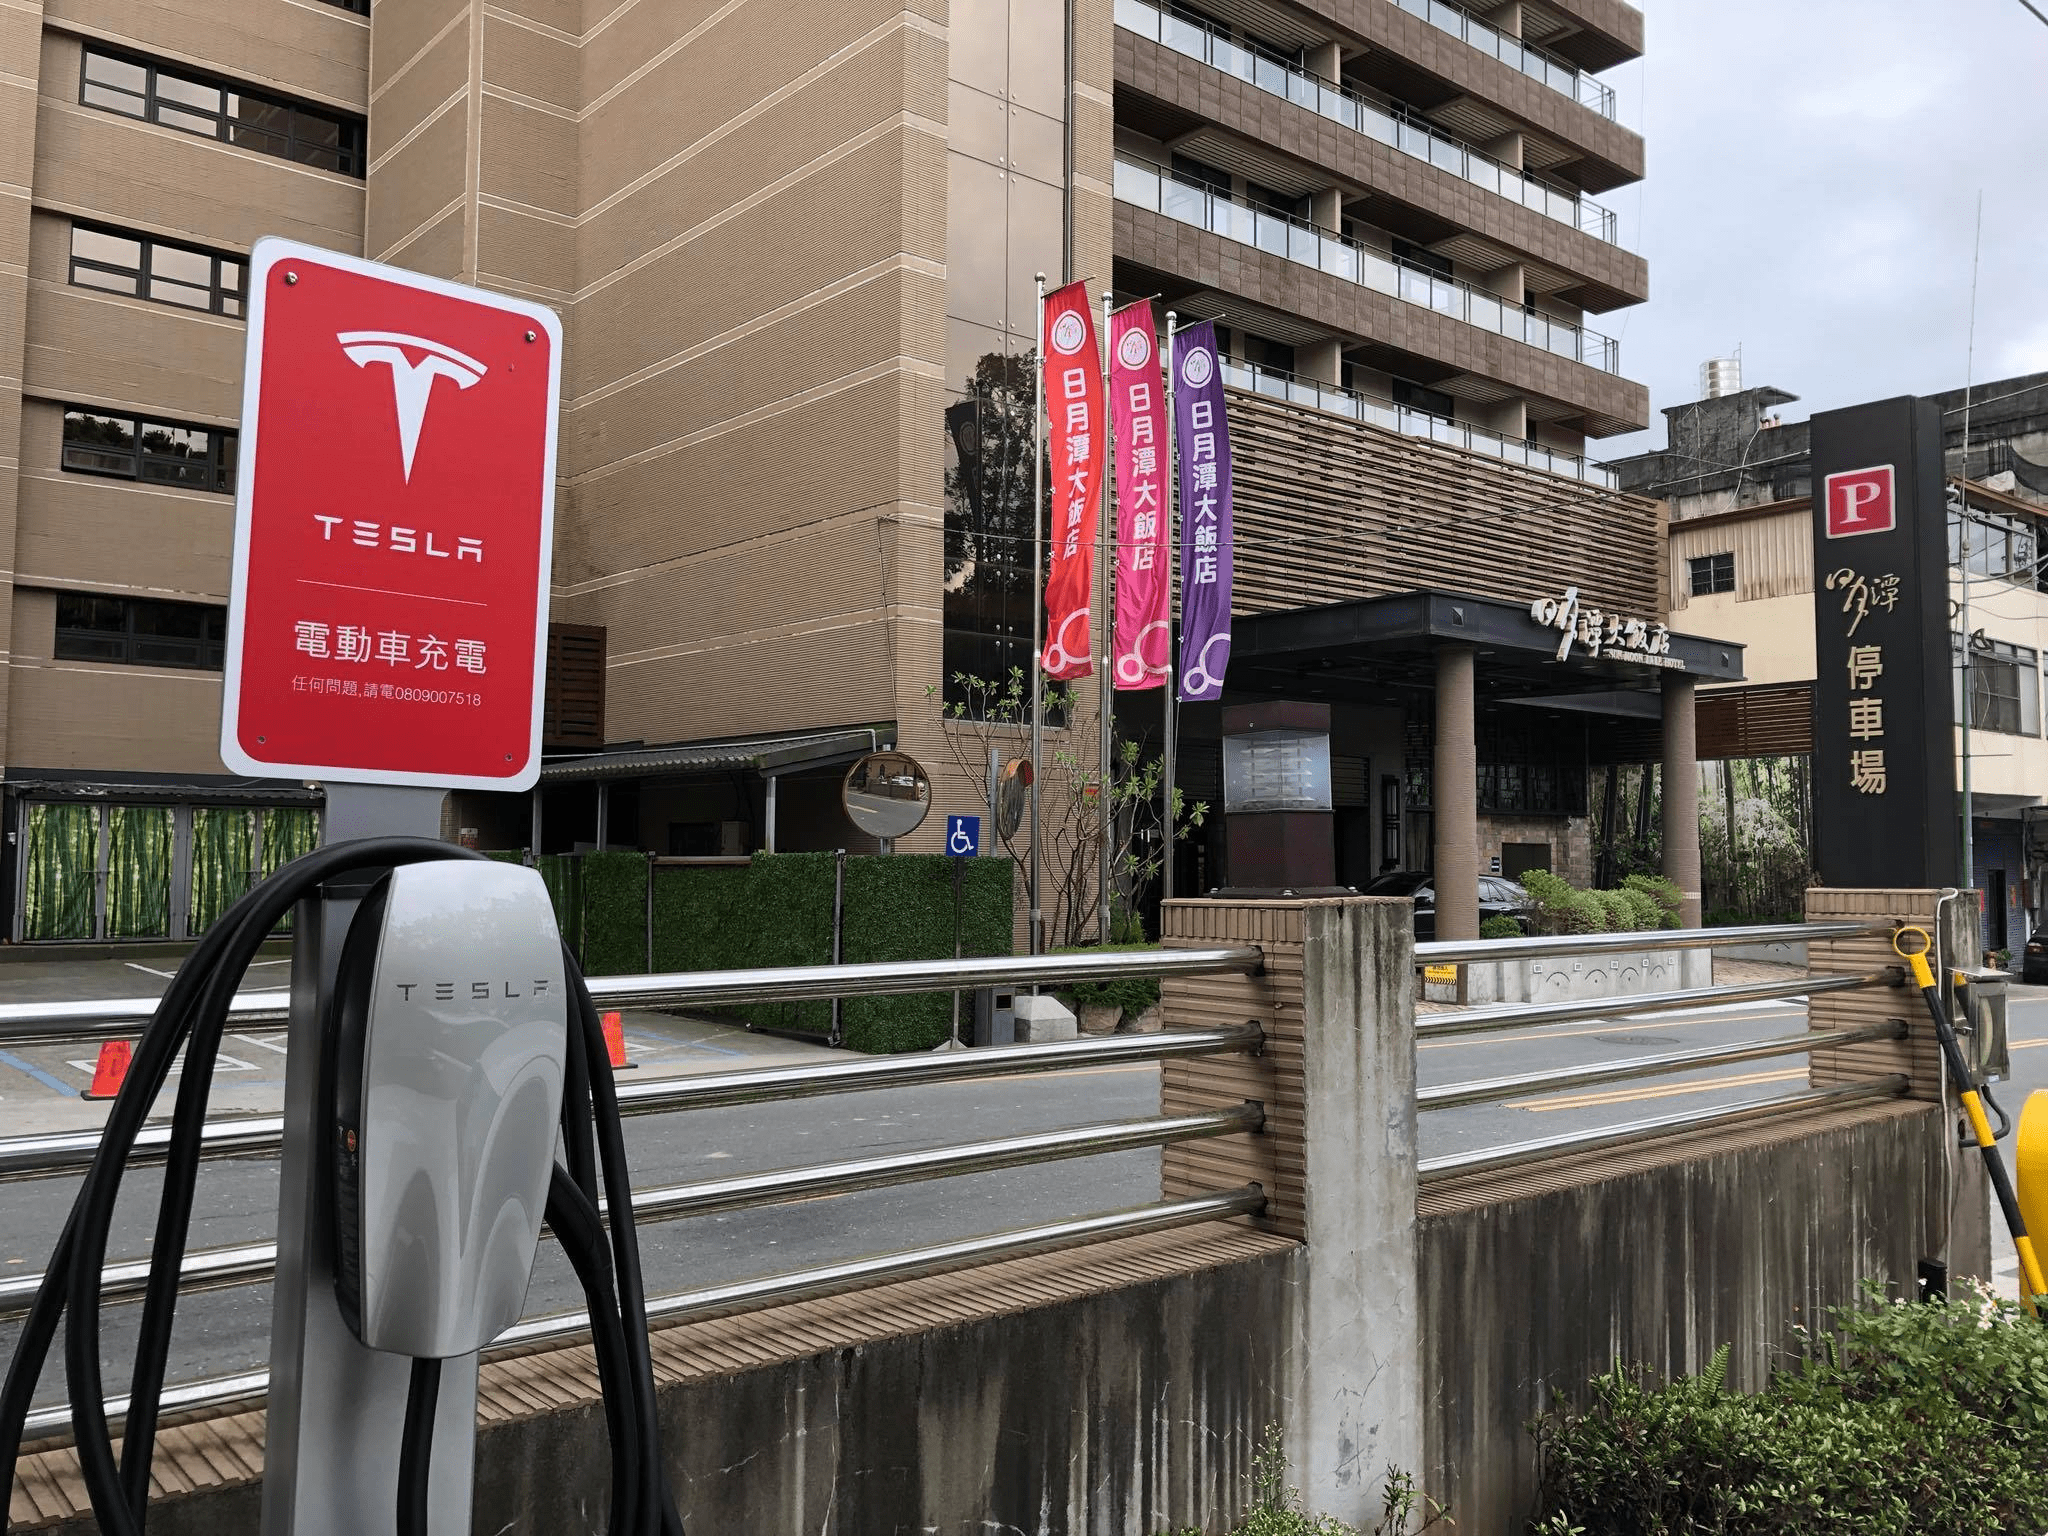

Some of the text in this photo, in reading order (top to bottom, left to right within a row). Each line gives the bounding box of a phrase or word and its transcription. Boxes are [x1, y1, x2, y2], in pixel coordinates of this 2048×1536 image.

[1062, 368, 1089, 561] 日月潭大飯店
[1128, 382, 1157, 572] 日月潭大飯店
[1191, 400, 1218, 585] 日月潭大飯店
[1838, 482, 1881, 524] P
[313, 514, 483, 563] TESLA
[294, 620, 487, 675] 電動車充電
[1847, 645, 1887, 795] 停車場
[396, 980, 549, 1001] TESLA
